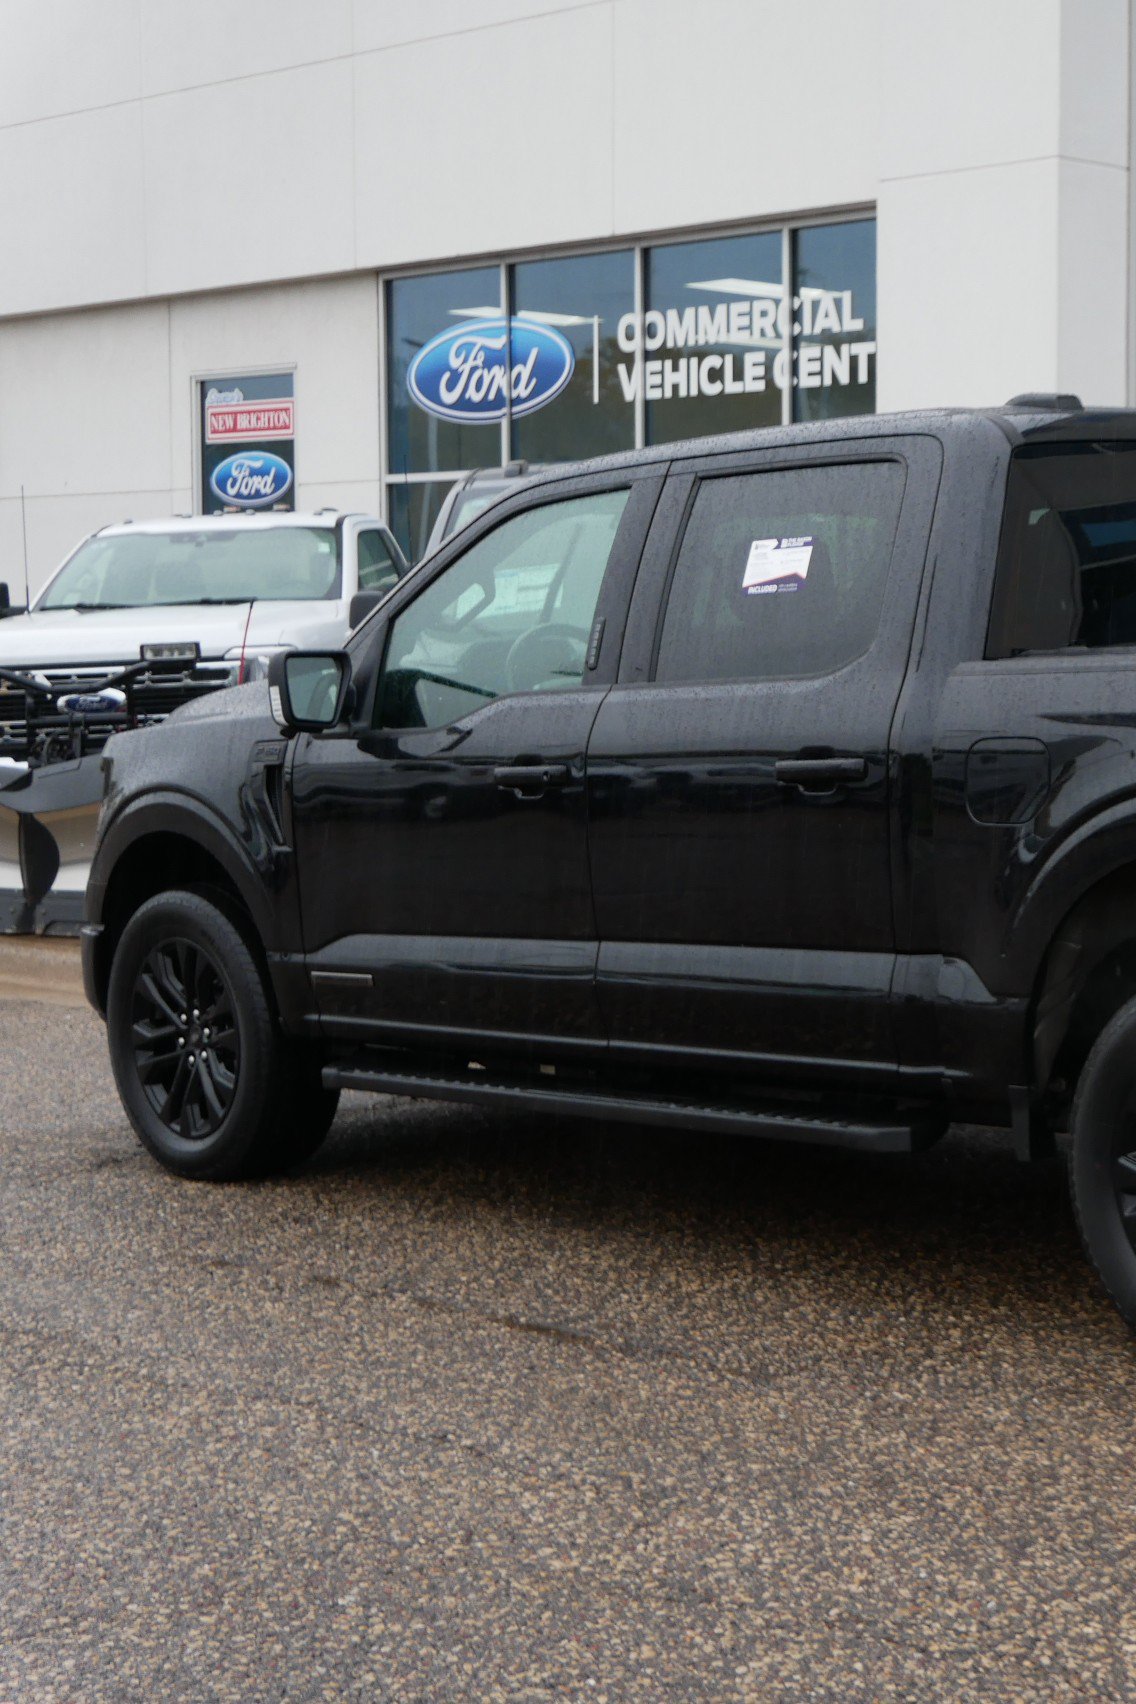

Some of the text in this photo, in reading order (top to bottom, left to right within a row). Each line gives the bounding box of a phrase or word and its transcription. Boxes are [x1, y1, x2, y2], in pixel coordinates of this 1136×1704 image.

[617, 290, 864, 353] COMMERCIAL
[439, 334, 538, 405] Ford
[617, 340, 877, 403] VEHICLE CENT
[210, 409, 290, 431] NEW BRIGHTON
[226, 459, 276, 497] Ford
